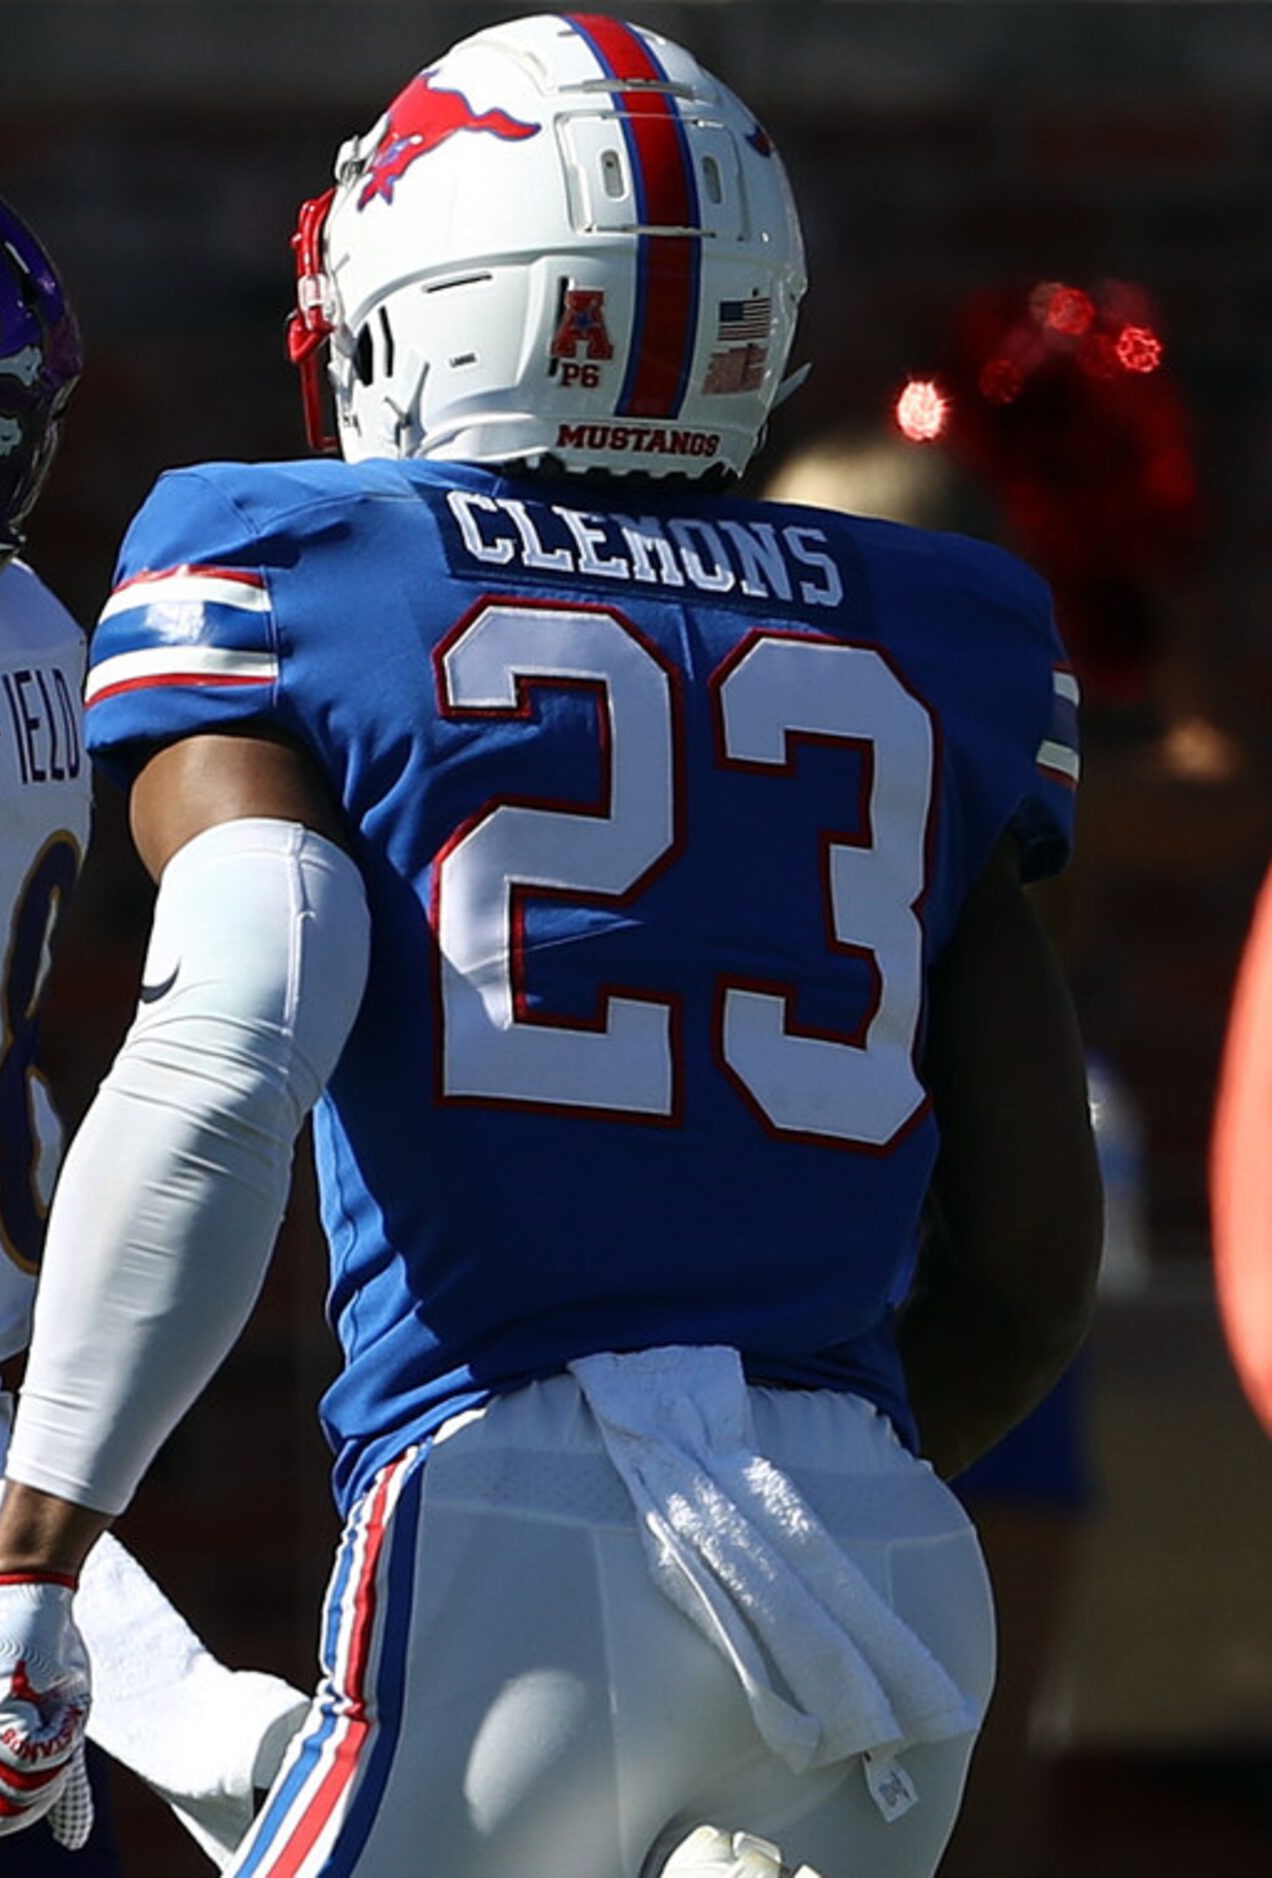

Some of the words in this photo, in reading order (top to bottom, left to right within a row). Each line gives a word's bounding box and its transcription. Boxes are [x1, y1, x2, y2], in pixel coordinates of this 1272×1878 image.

[560, 363, 601, 389] P6
[556, 424, 721, 458] MUSTANGS
[446, 490, 846, 608] CLEMONS
[431, 593, 942, 1156] 23
